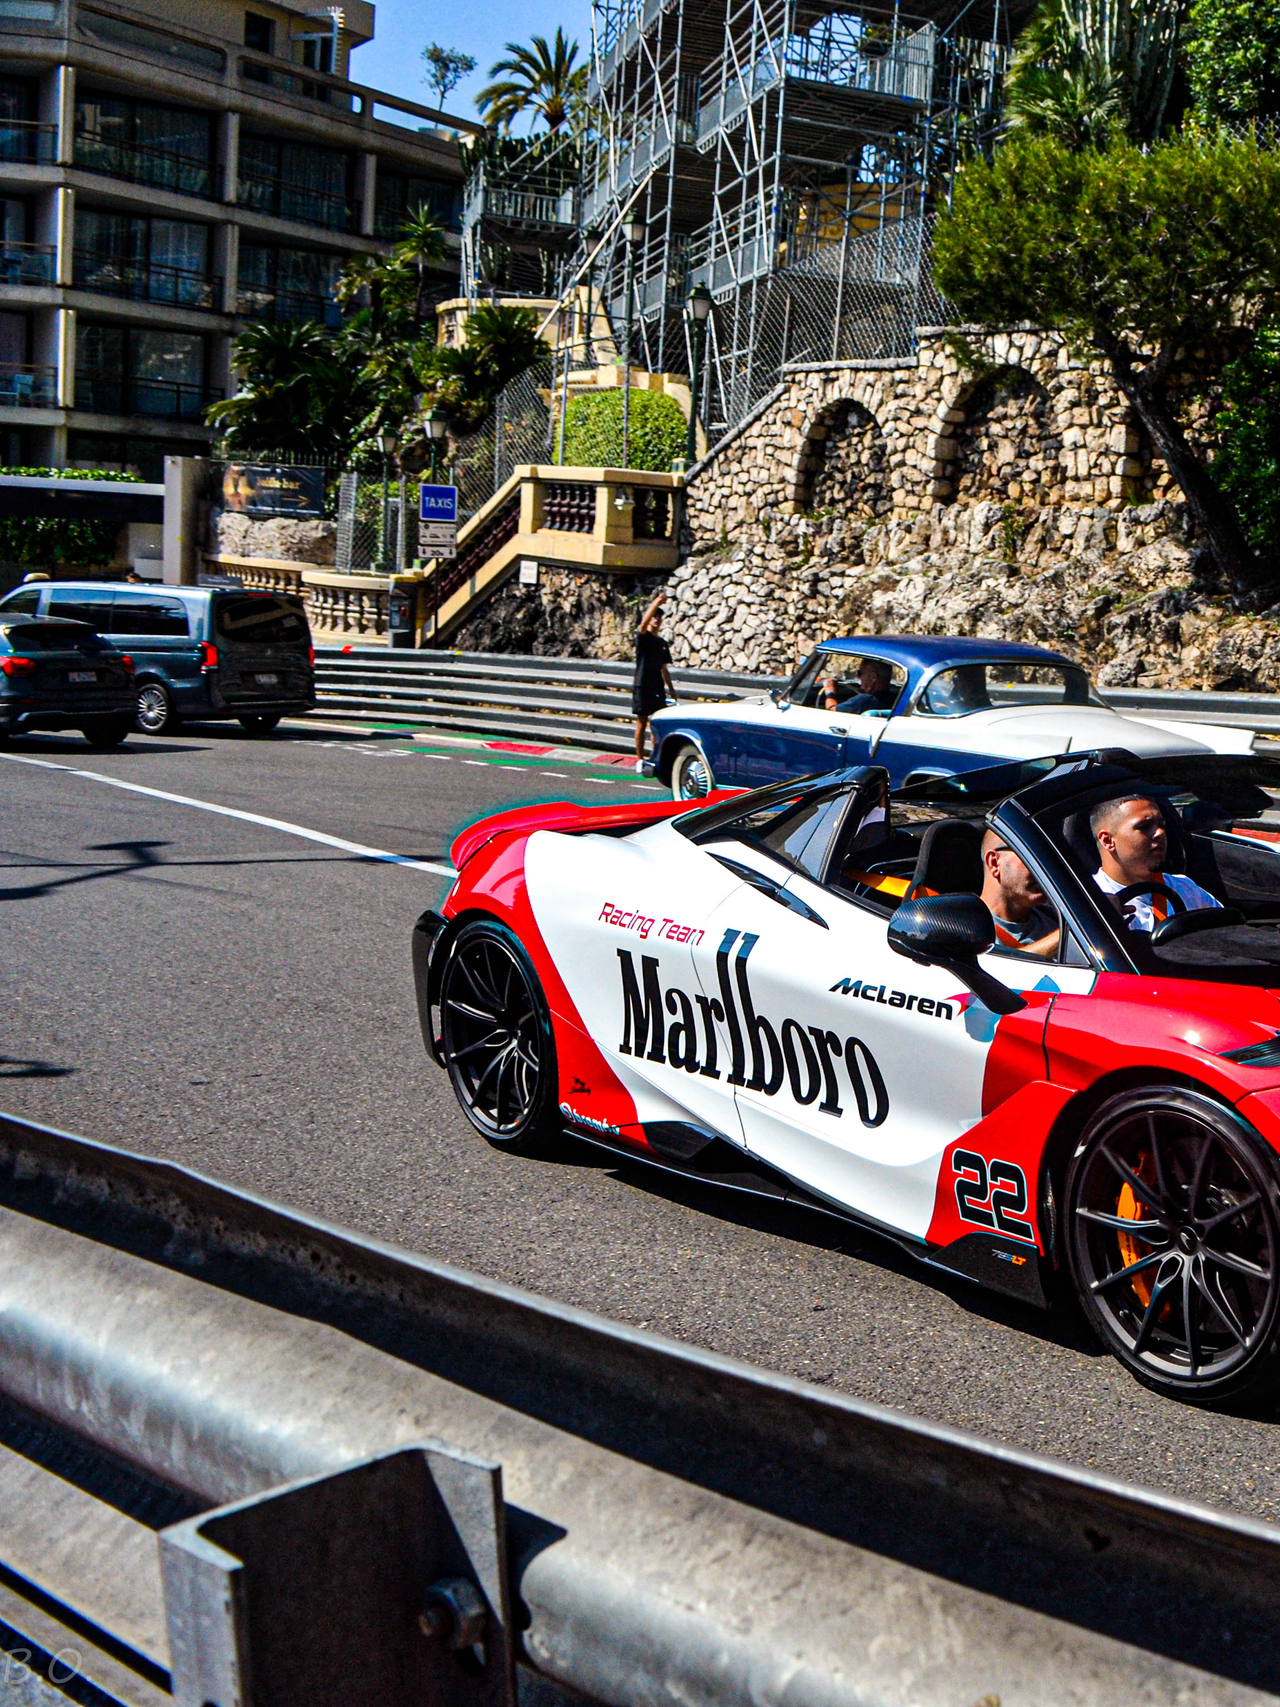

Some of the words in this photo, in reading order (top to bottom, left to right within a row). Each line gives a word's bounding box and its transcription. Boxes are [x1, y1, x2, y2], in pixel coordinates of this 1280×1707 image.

[424, 496, 454, 509] TAXIS
[598, 902, 655, 939] Racing
[658, 918, 705, 946] Team
[828, 977, 953, 1020] McLaren
[617, 928, 889, 1128] Marlboro
[952, 1148, 1035, 1242] 22
